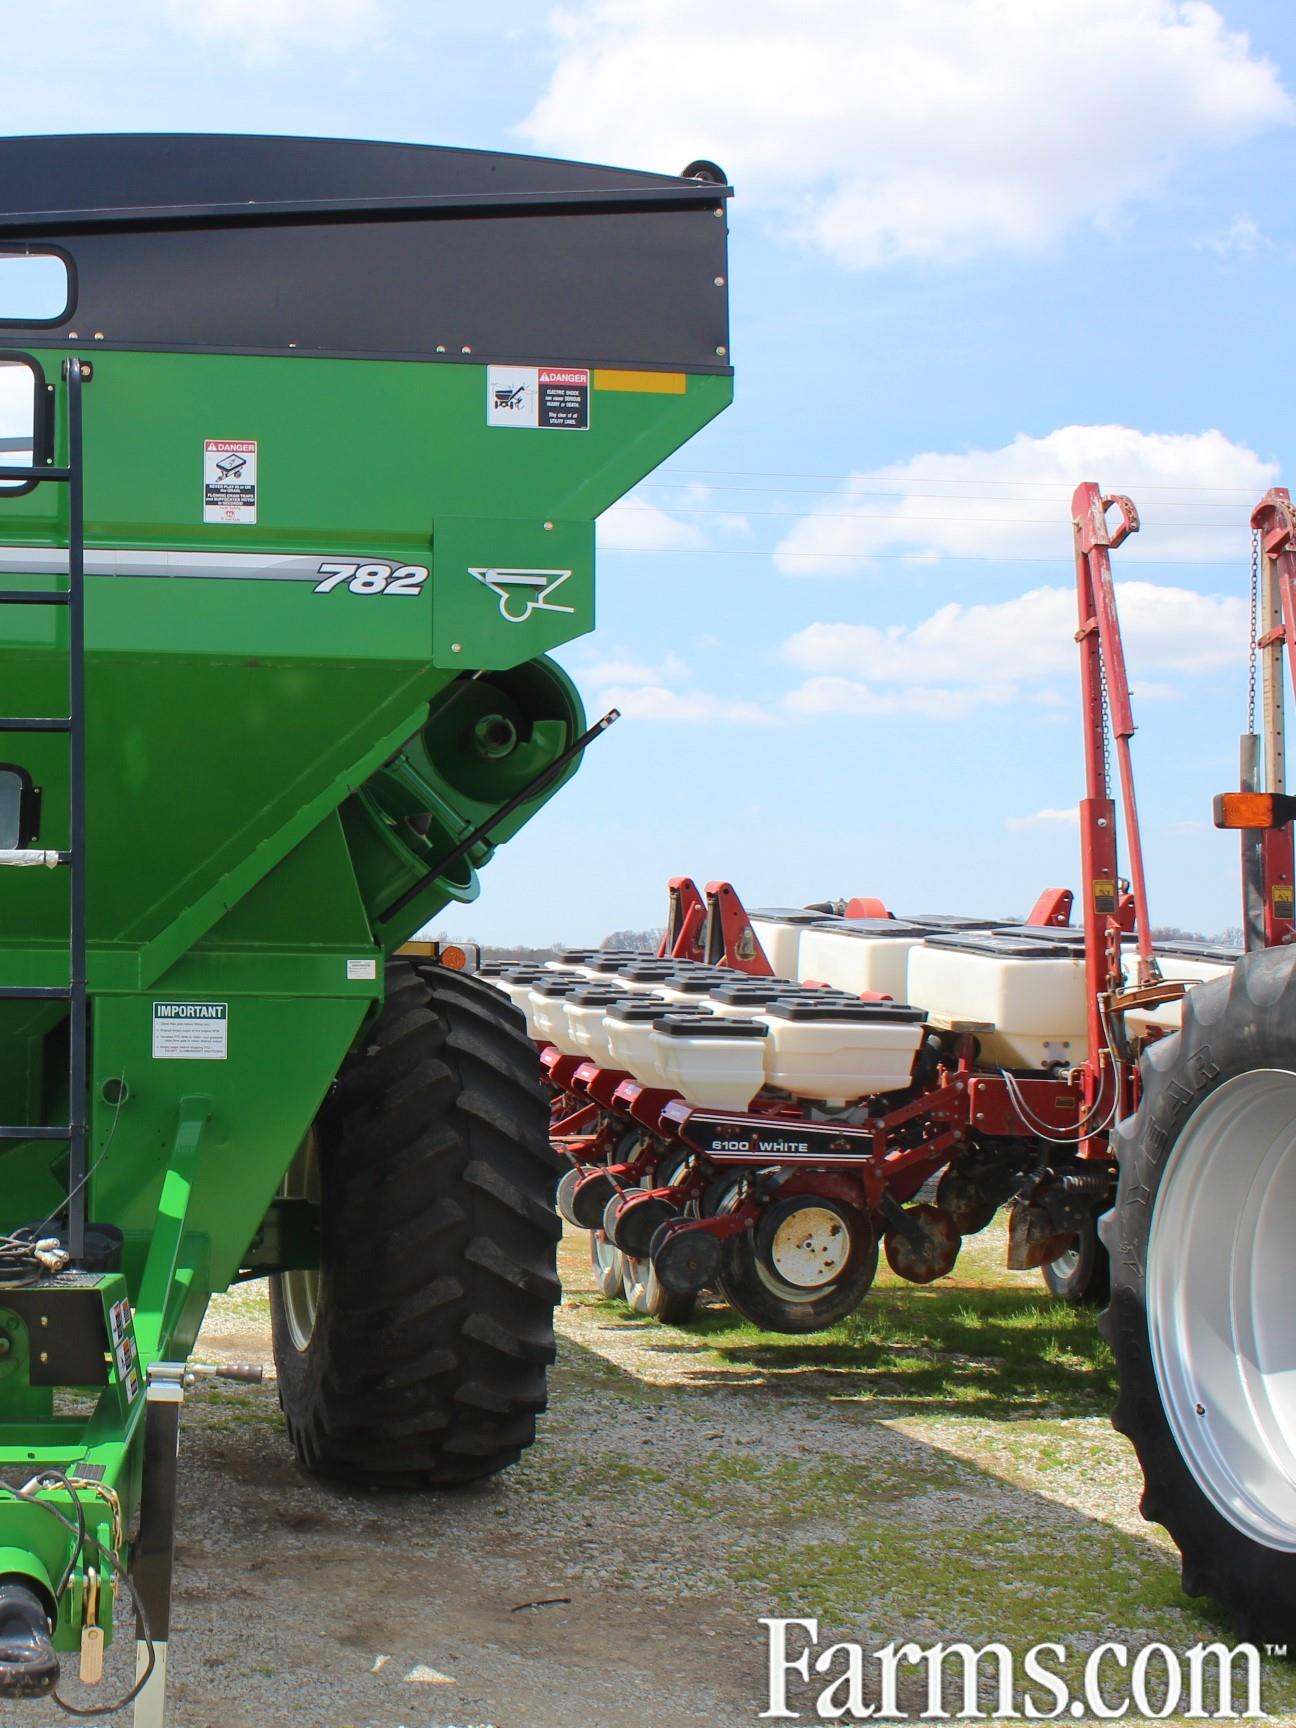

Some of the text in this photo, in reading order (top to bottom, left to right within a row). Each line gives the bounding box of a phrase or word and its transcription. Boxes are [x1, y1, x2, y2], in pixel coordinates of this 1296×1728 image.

[549, 373, 587, 383] DANGER
[217, 444, 255, 452] DANGER
[312, 562, 430, 596] 782
[157, 1005, 224, 1018] IMPORTANT
[711, 1140, 809, 1152] 6100 WHITE
